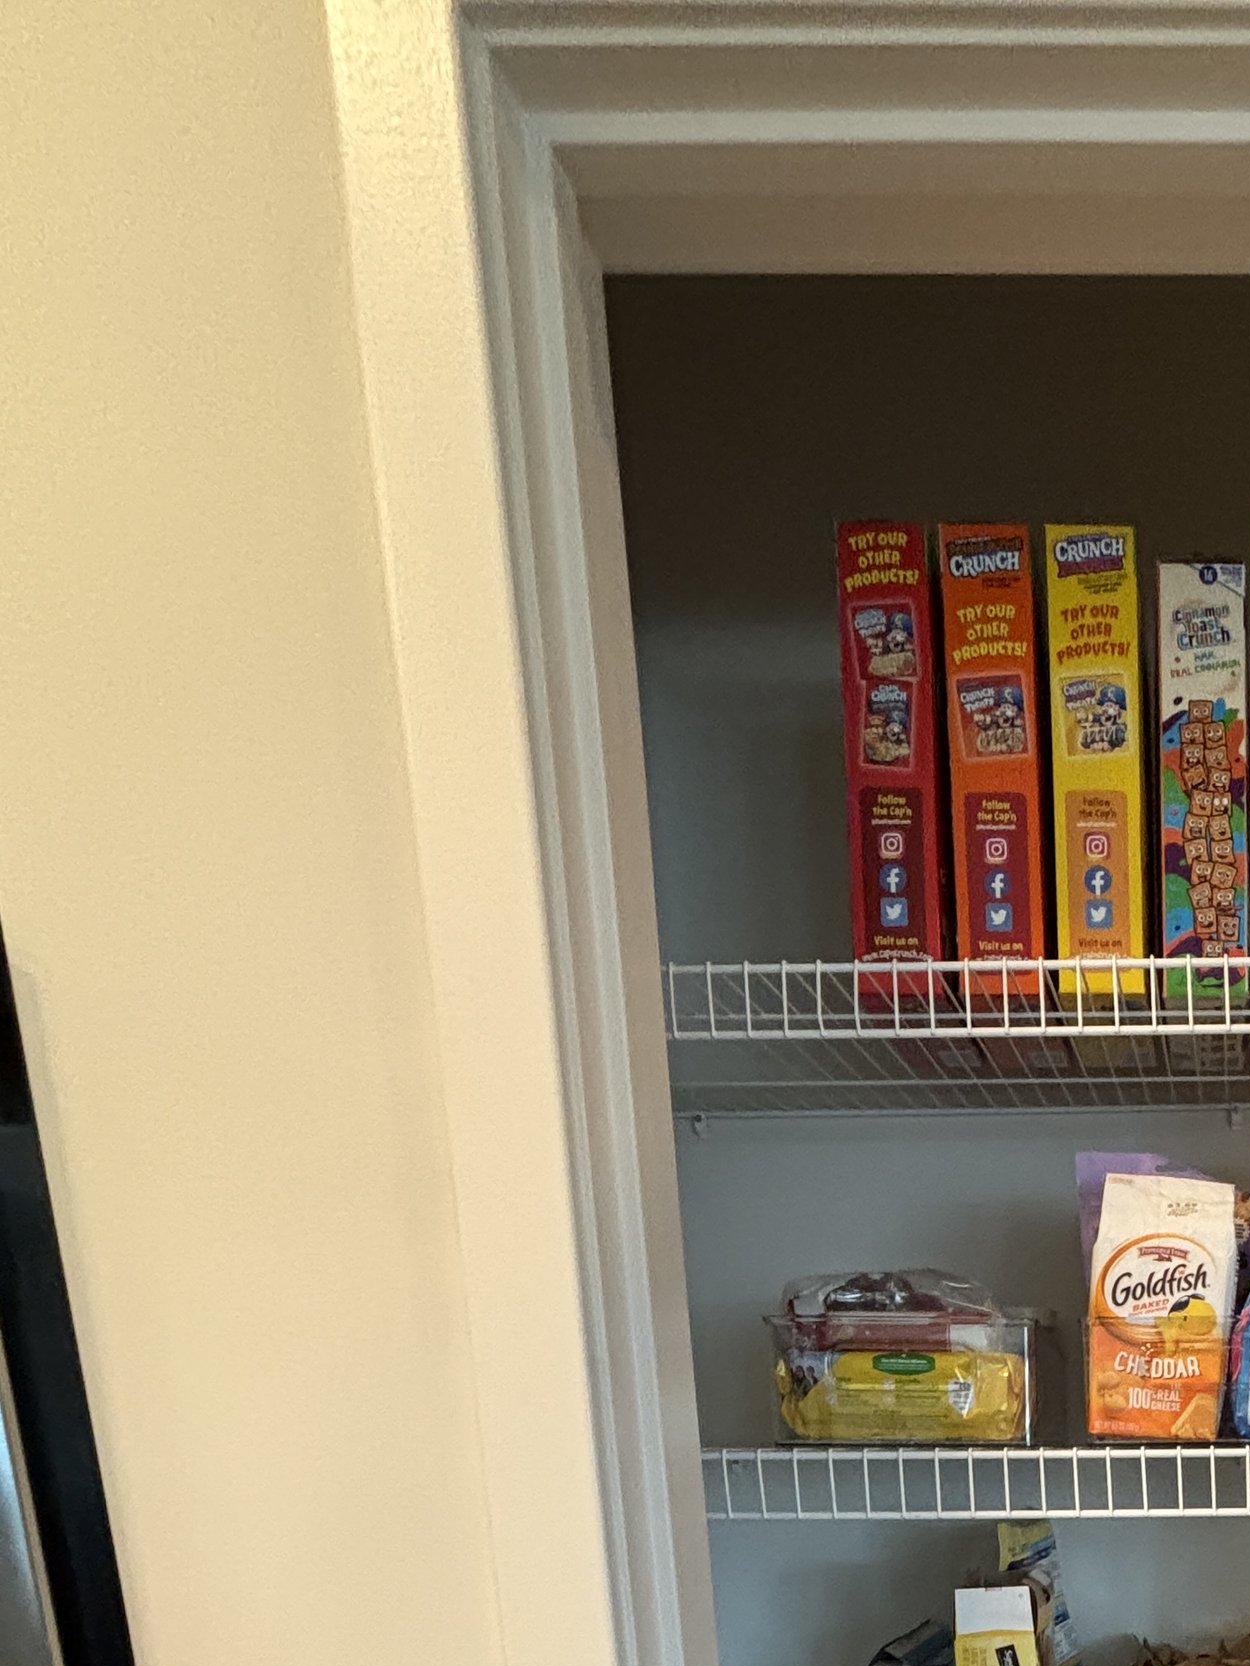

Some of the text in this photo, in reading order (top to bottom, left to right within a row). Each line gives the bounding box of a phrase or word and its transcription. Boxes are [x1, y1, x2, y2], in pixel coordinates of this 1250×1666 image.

[848, 531, 908, 550] TRY OUR
[1055, 538, 1124, 562] CRUNCH
[859, 549, 901, 568] OTHER
[950, 551, 1020, 576] CRUNCH
[844, 569, 919, 592] PRODUCTS!
[957, 603, 1015, 623] TRY OUR
[1061, 604, 1119, 622] TRY OUR
[966, 621, 1009, 640] OTHER
[1070, 622, 1112, 641] OTHER
[1179, 627, 1230, 648] Crunch
[953, 641, 1027, 665] PRODUCTS!
[1057, 642, 1130, 665] PRODUCTS!
[877, 795, 906, 806] Follow
[982, 800, 1011, 810] Follow
[872, 806, 888, 816] the
[977, 811, 993, 821] the
[874, 936, 919, 946] Visit us on
[978, 941, 1023, 951] Visit us on
[1078, 938, 1122, 948] Visit us on
[1111, 1263, 1207, 1307] Goldfish
[1132, 1299, 1169, 1312] BAKED
[1114, 1351, 1200, 1379] CHEDDAR
